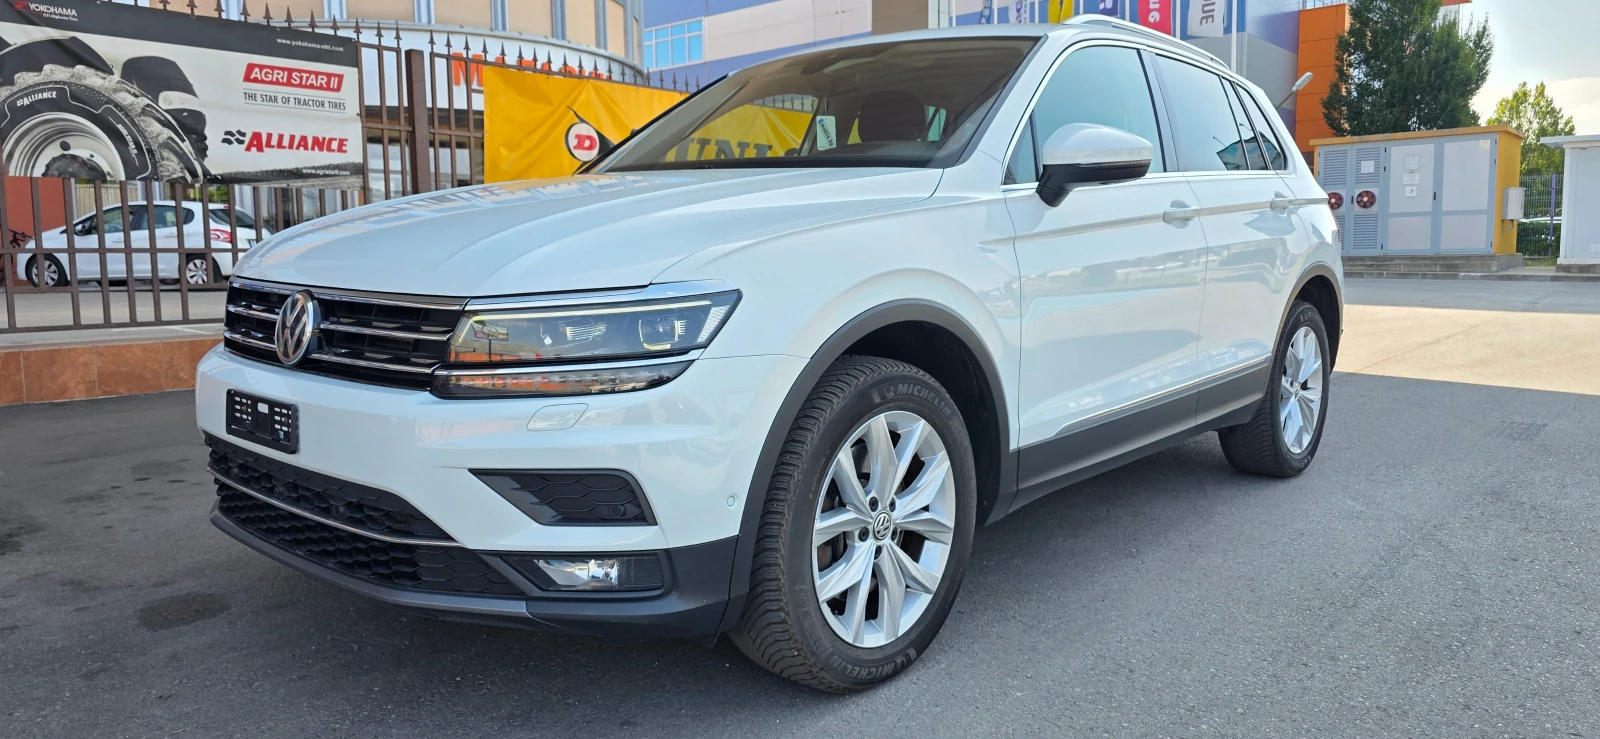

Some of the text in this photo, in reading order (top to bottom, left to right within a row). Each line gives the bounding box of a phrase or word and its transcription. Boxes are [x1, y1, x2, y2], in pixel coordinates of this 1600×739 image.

[28, 3, 78, 17] YOKOHAMA
[249, 67, 339, 89] AGRI STAR II
[24, 91, 57, 106] ALLIANCE
[243, 91, 346, 111] THE STAR OF TRACTOR TIRES
[244, 131, 349, 154] ALLIANCE
[573, 133, 598, 151] D
[896, 383, 952, 417] MICHELIN
[829, 654, 895, 680] MICHELIN
